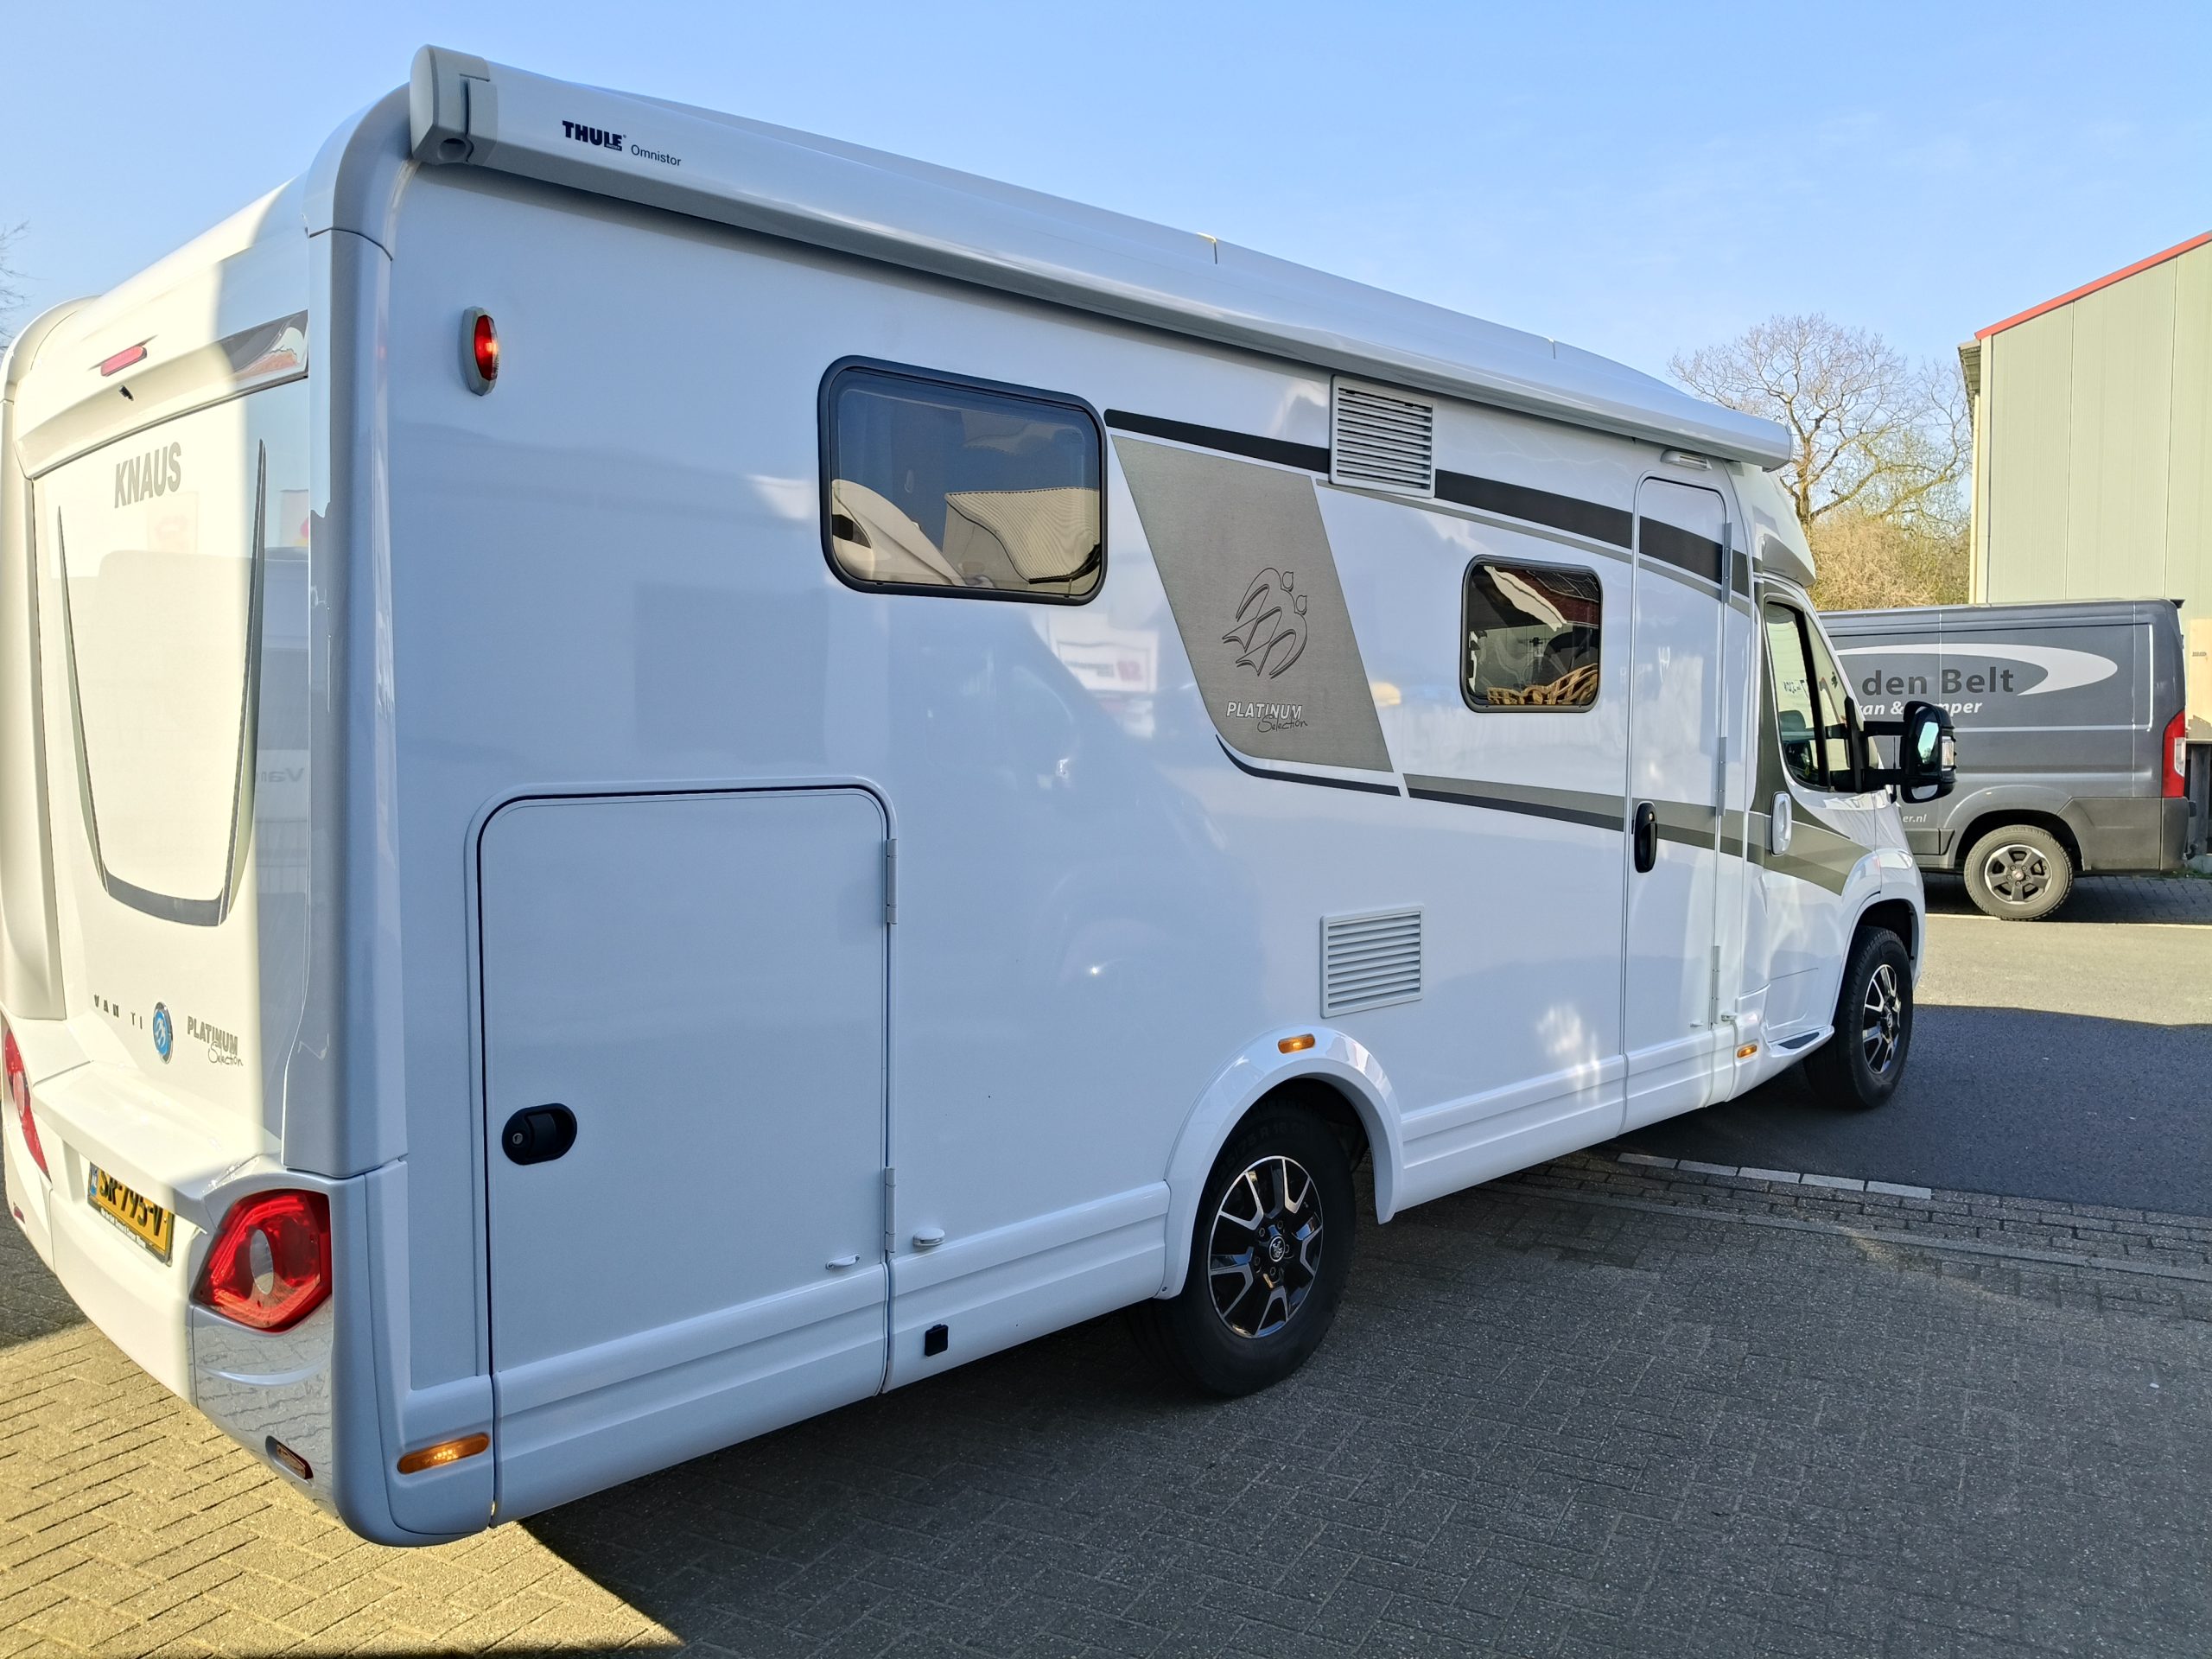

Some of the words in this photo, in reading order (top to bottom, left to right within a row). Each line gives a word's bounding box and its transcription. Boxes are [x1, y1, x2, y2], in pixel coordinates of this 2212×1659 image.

[563, 120, 622, 149] THULE
[631, 144, 682, 166] Omnistor
[114, 442, 181, 509] KNAUS
[1862, 670, 1928, 696] den
[1942, 666, 2014, 694] Belt
[1226, 701, 1303, 720] PLATINUM
[1257, 714, 1308, 733] Selection
[1890, 701, 1904, 715] &
[93, 994, 120, 1019] VAN
[130, 1012, 143, 1030] TI
[188, 1015, 238, 1056] PLATINUM
